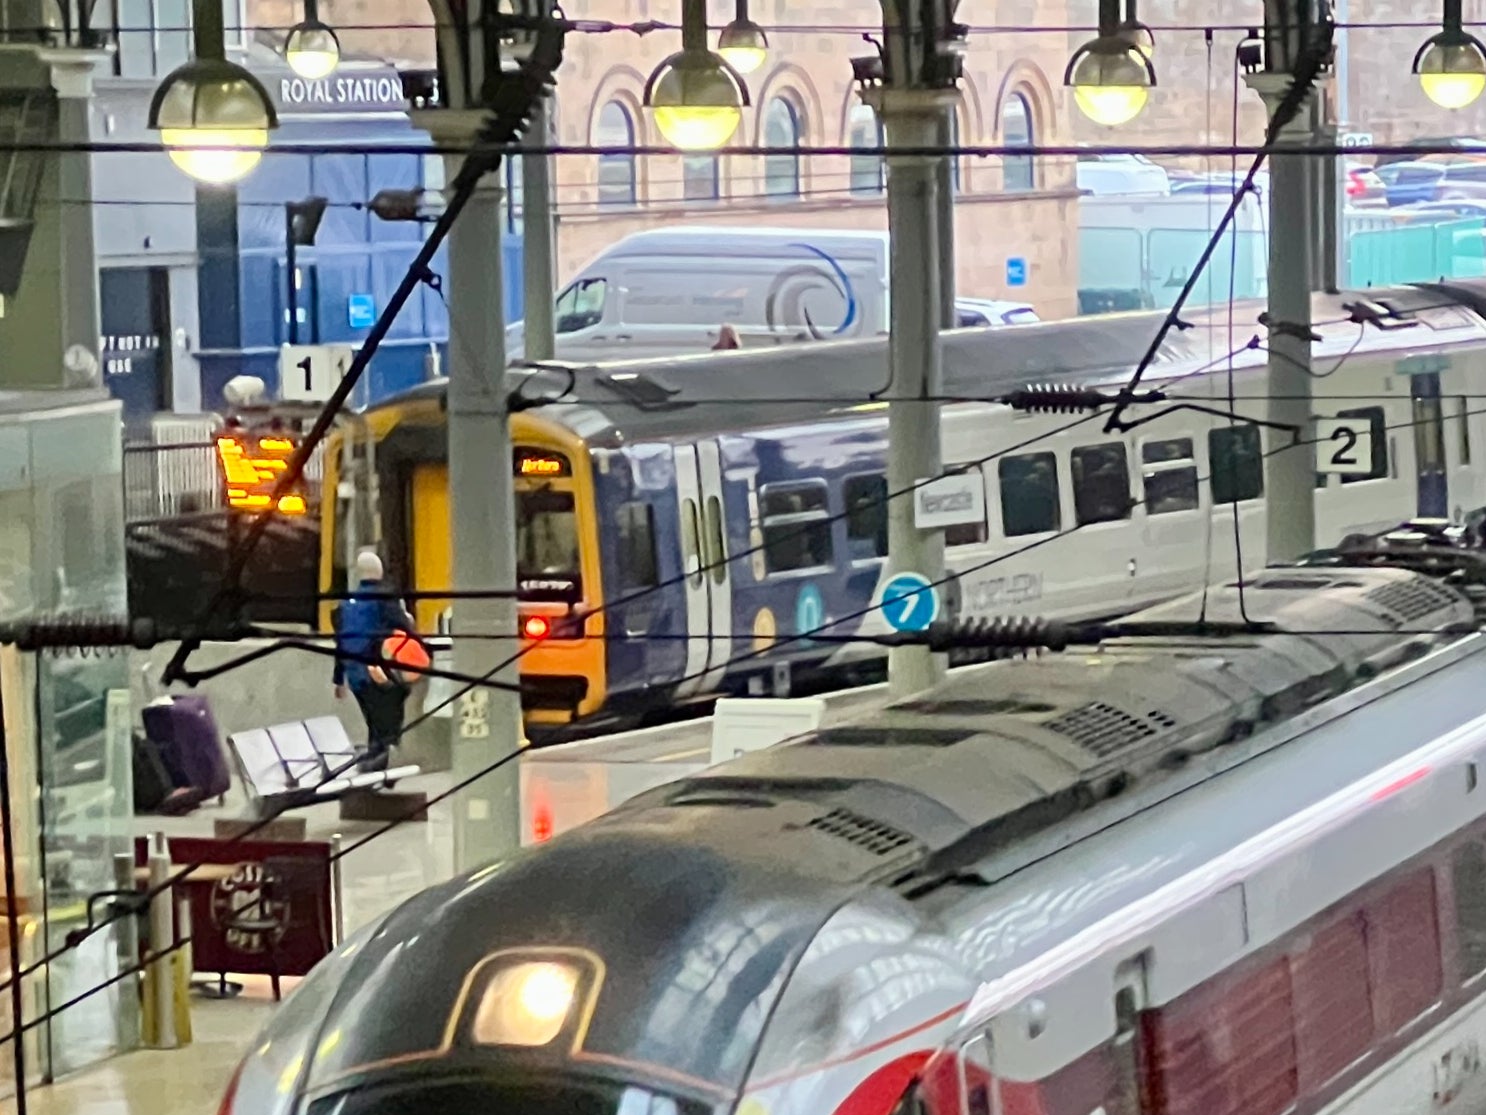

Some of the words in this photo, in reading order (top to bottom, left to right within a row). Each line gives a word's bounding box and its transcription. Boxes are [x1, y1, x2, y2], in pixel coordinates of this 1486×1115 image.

[281, 78, 333, 103] ROYAL
[336, 78, 404, 103] STATION
[297, 356, 312, 391] 1
[1331, 426, 1358, 465] 2
[896, 591, 919, 624] 7
